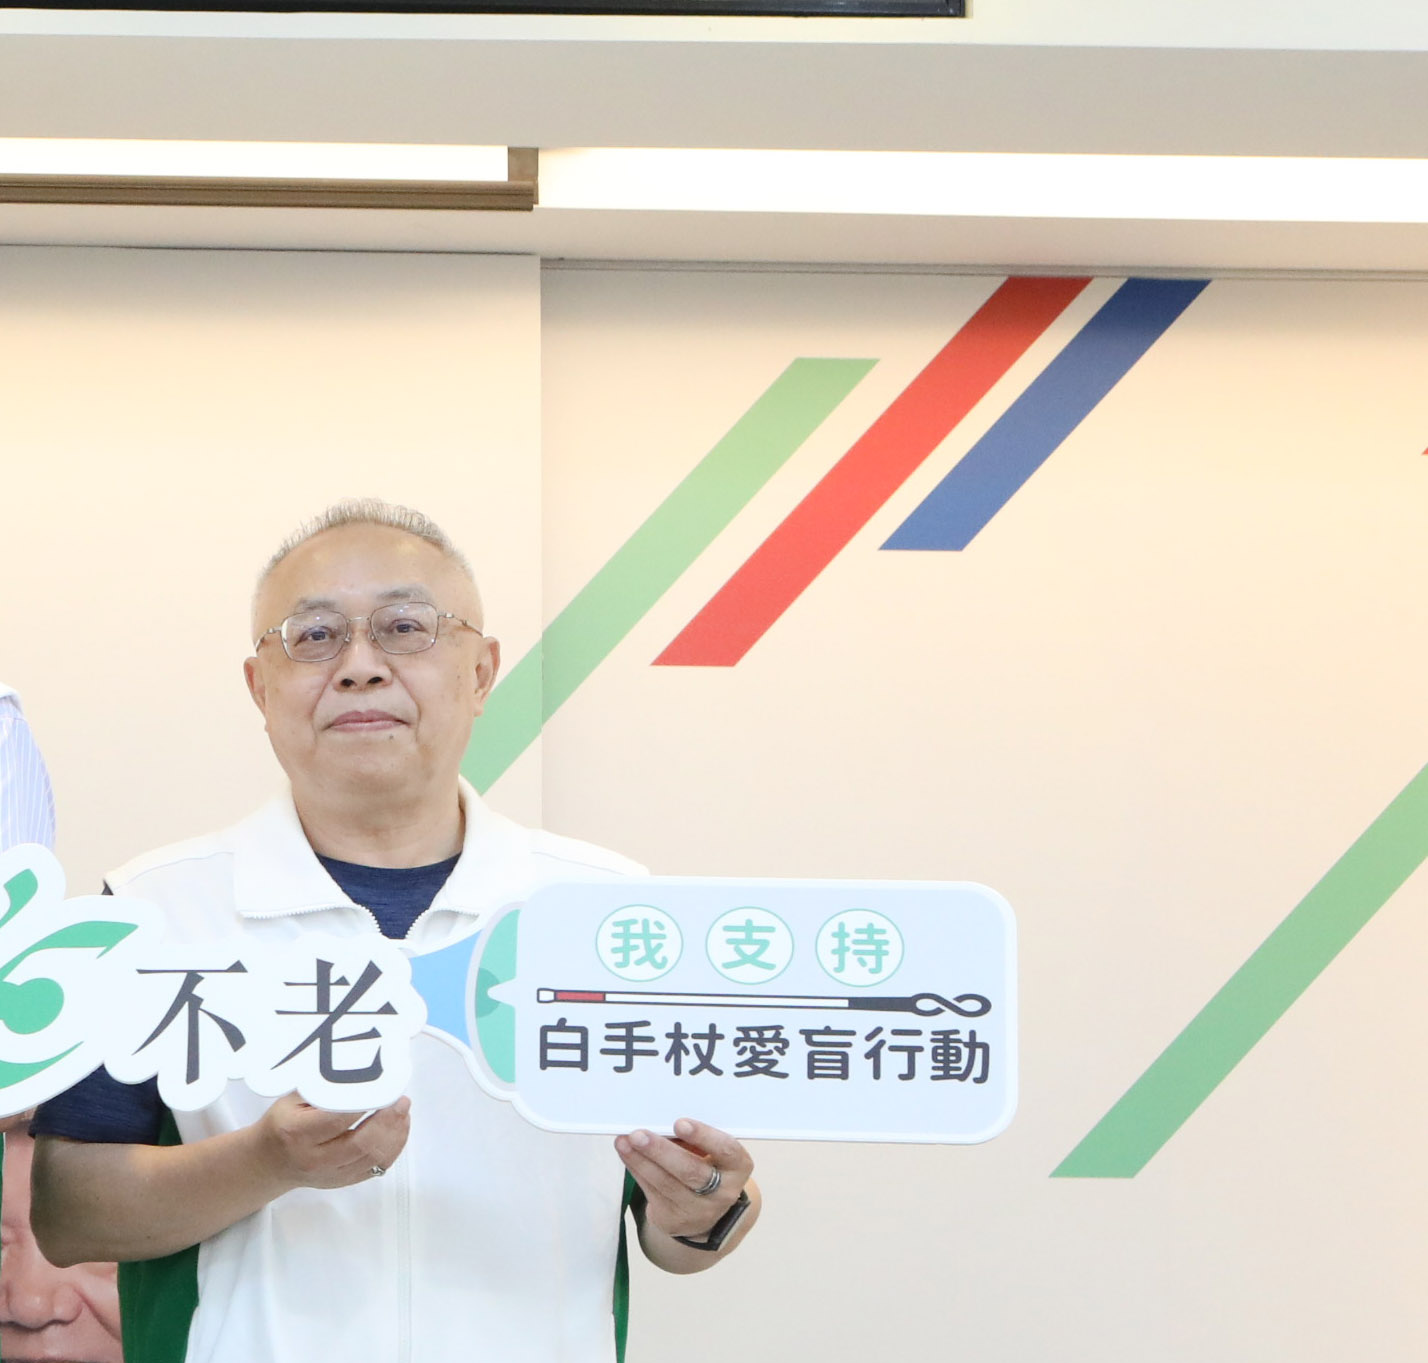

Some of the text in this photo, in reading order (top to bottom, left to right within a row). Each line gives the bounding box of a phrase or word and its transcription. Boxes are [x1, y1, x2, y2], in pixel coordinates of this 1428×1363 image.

[610, 918, 891, 975] 我支持
[539, 1017, 991, 1084] 白手杖愛盲行動
